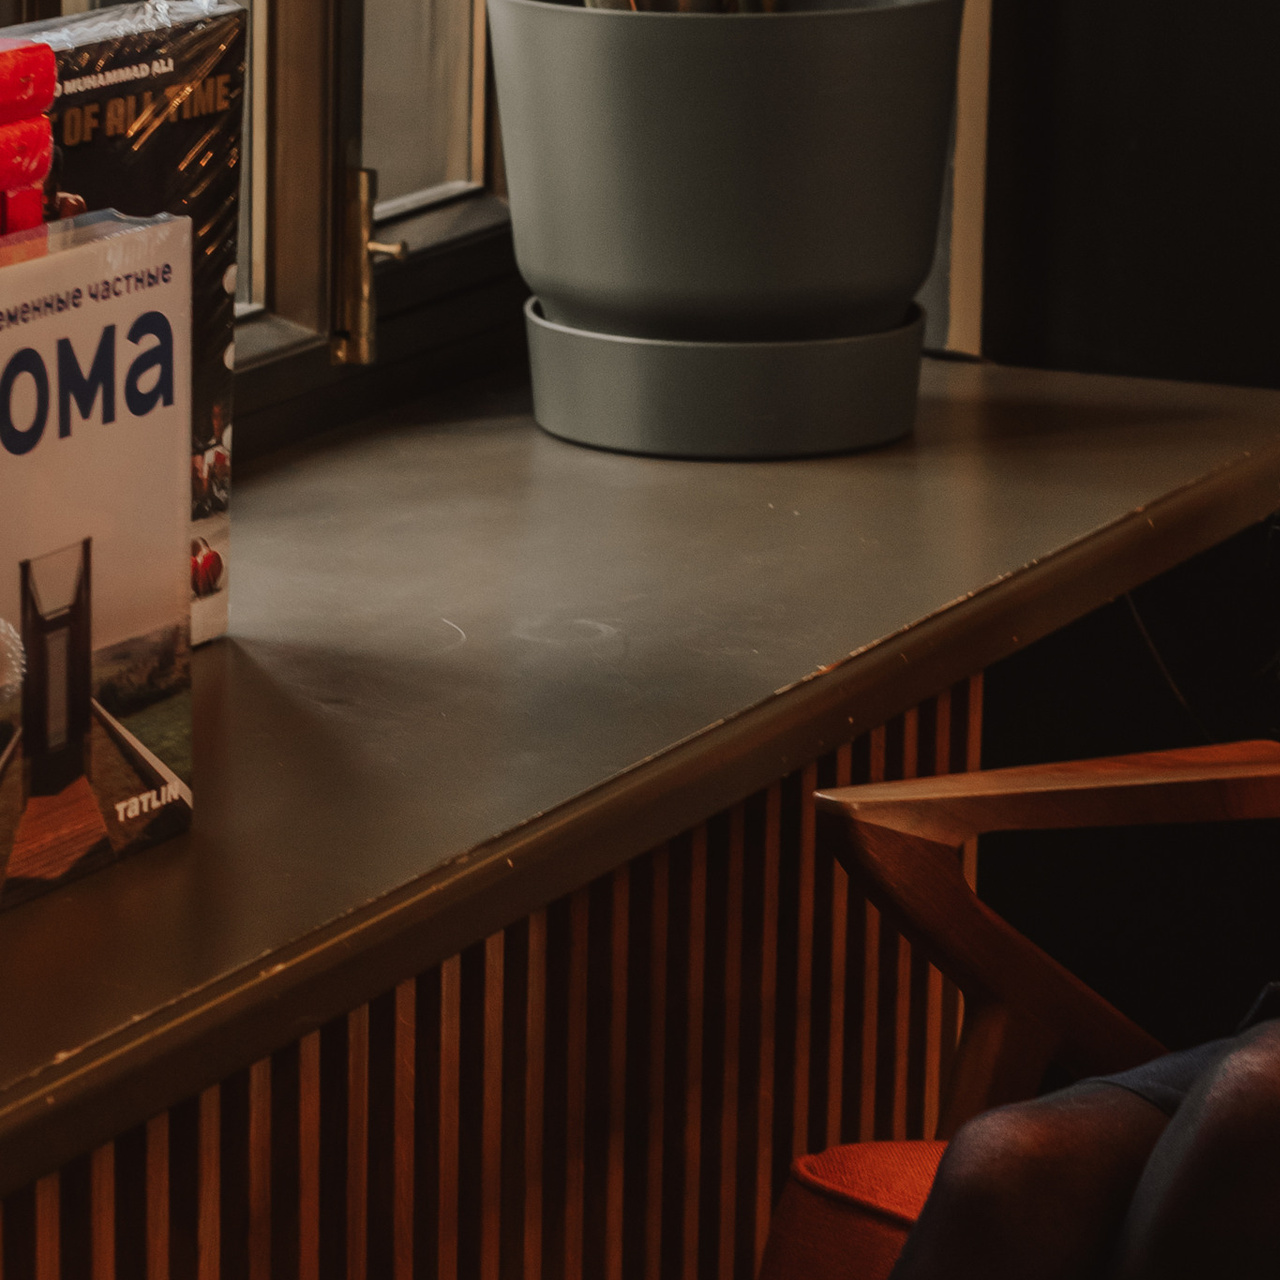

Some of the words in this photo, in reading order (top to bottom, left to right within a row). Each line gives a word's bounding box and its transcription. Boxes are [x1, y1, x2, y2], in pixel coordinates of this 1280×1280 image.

[63, 62, 150, 95] MUHAMMAD
[62, 102, 99, 147] OF
[163, 73, 231, 123] TIME
[87, 262, 173, 302] частные
